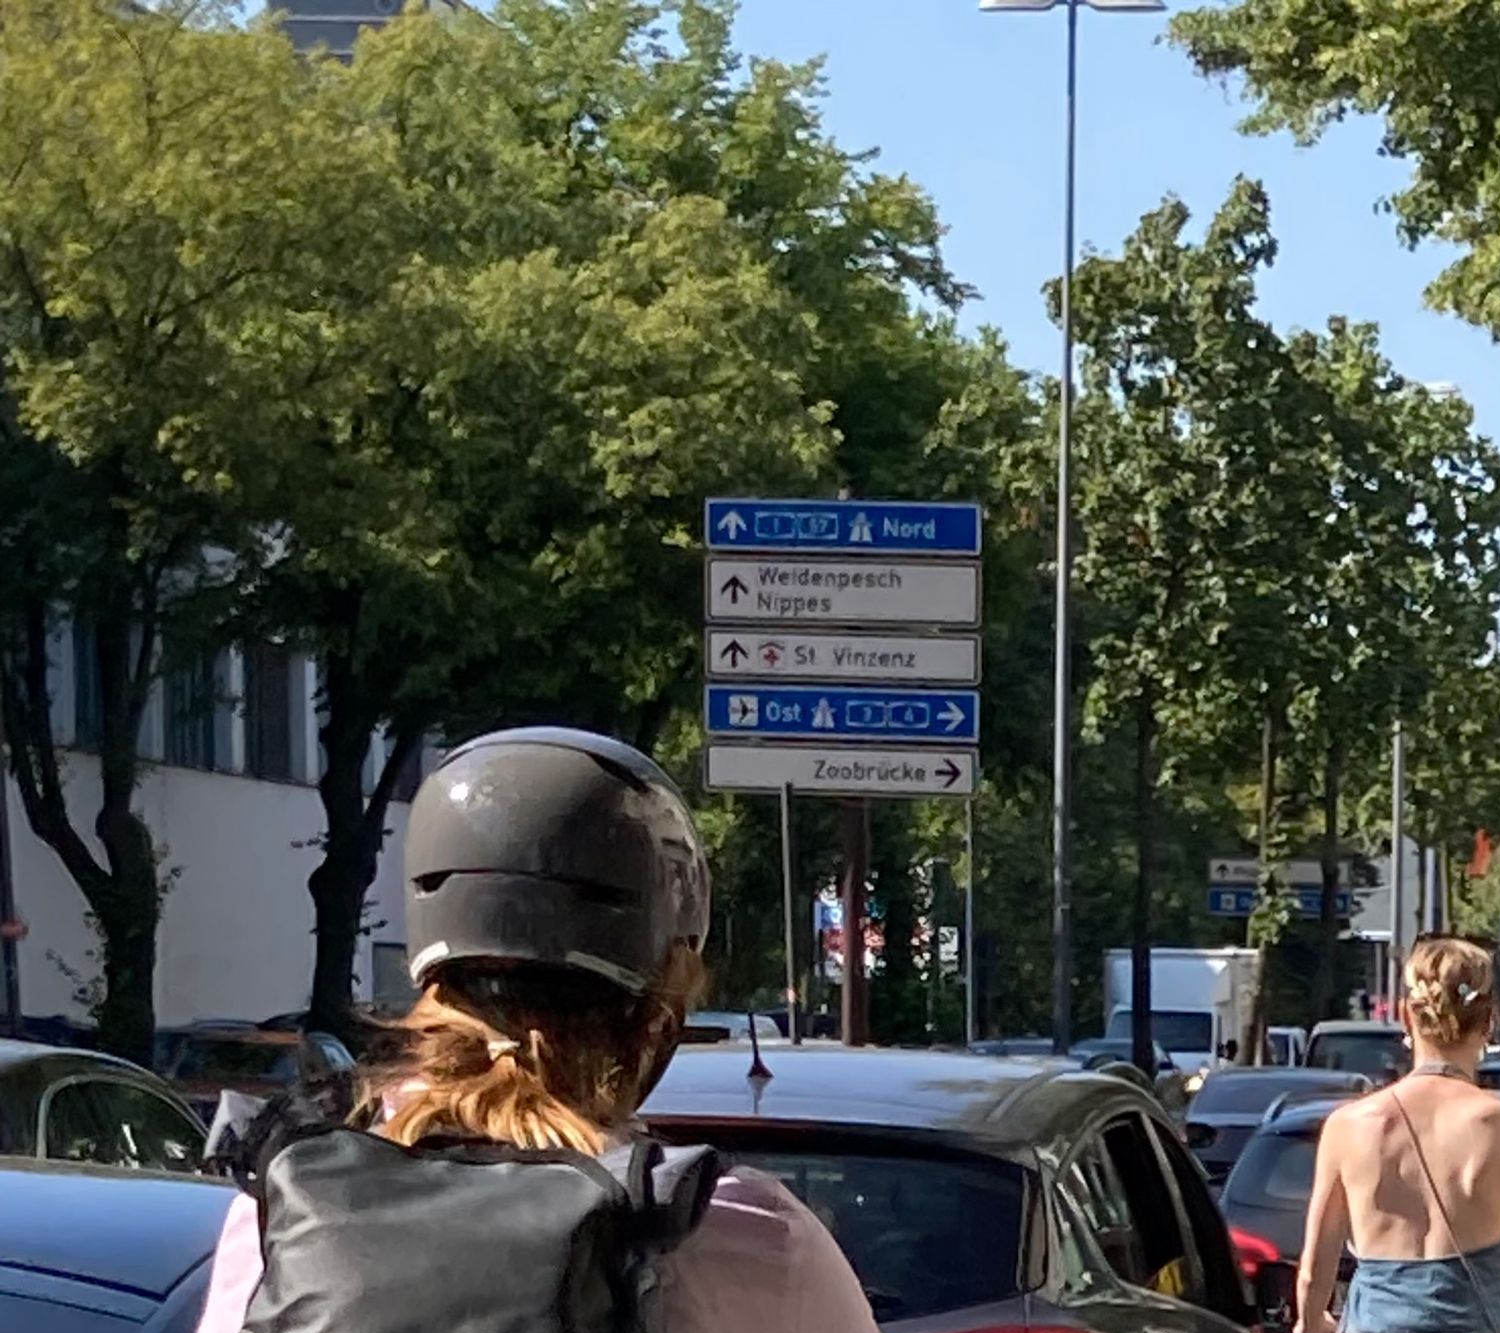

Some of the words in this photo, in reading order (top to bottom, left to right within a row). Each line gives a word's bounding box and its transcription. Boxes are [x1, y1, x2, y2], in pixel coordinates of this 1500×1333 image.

[883, 516, 936, 540] Nord
[758, 566, 902, 591] Weidenpesch
[757, 592, 832, 616] Nippes
[832, 646, 917, 669] Vinzenz
[765, 700, 802, 723] Ost
[813, 758, 927, 783] Zoobrücke
